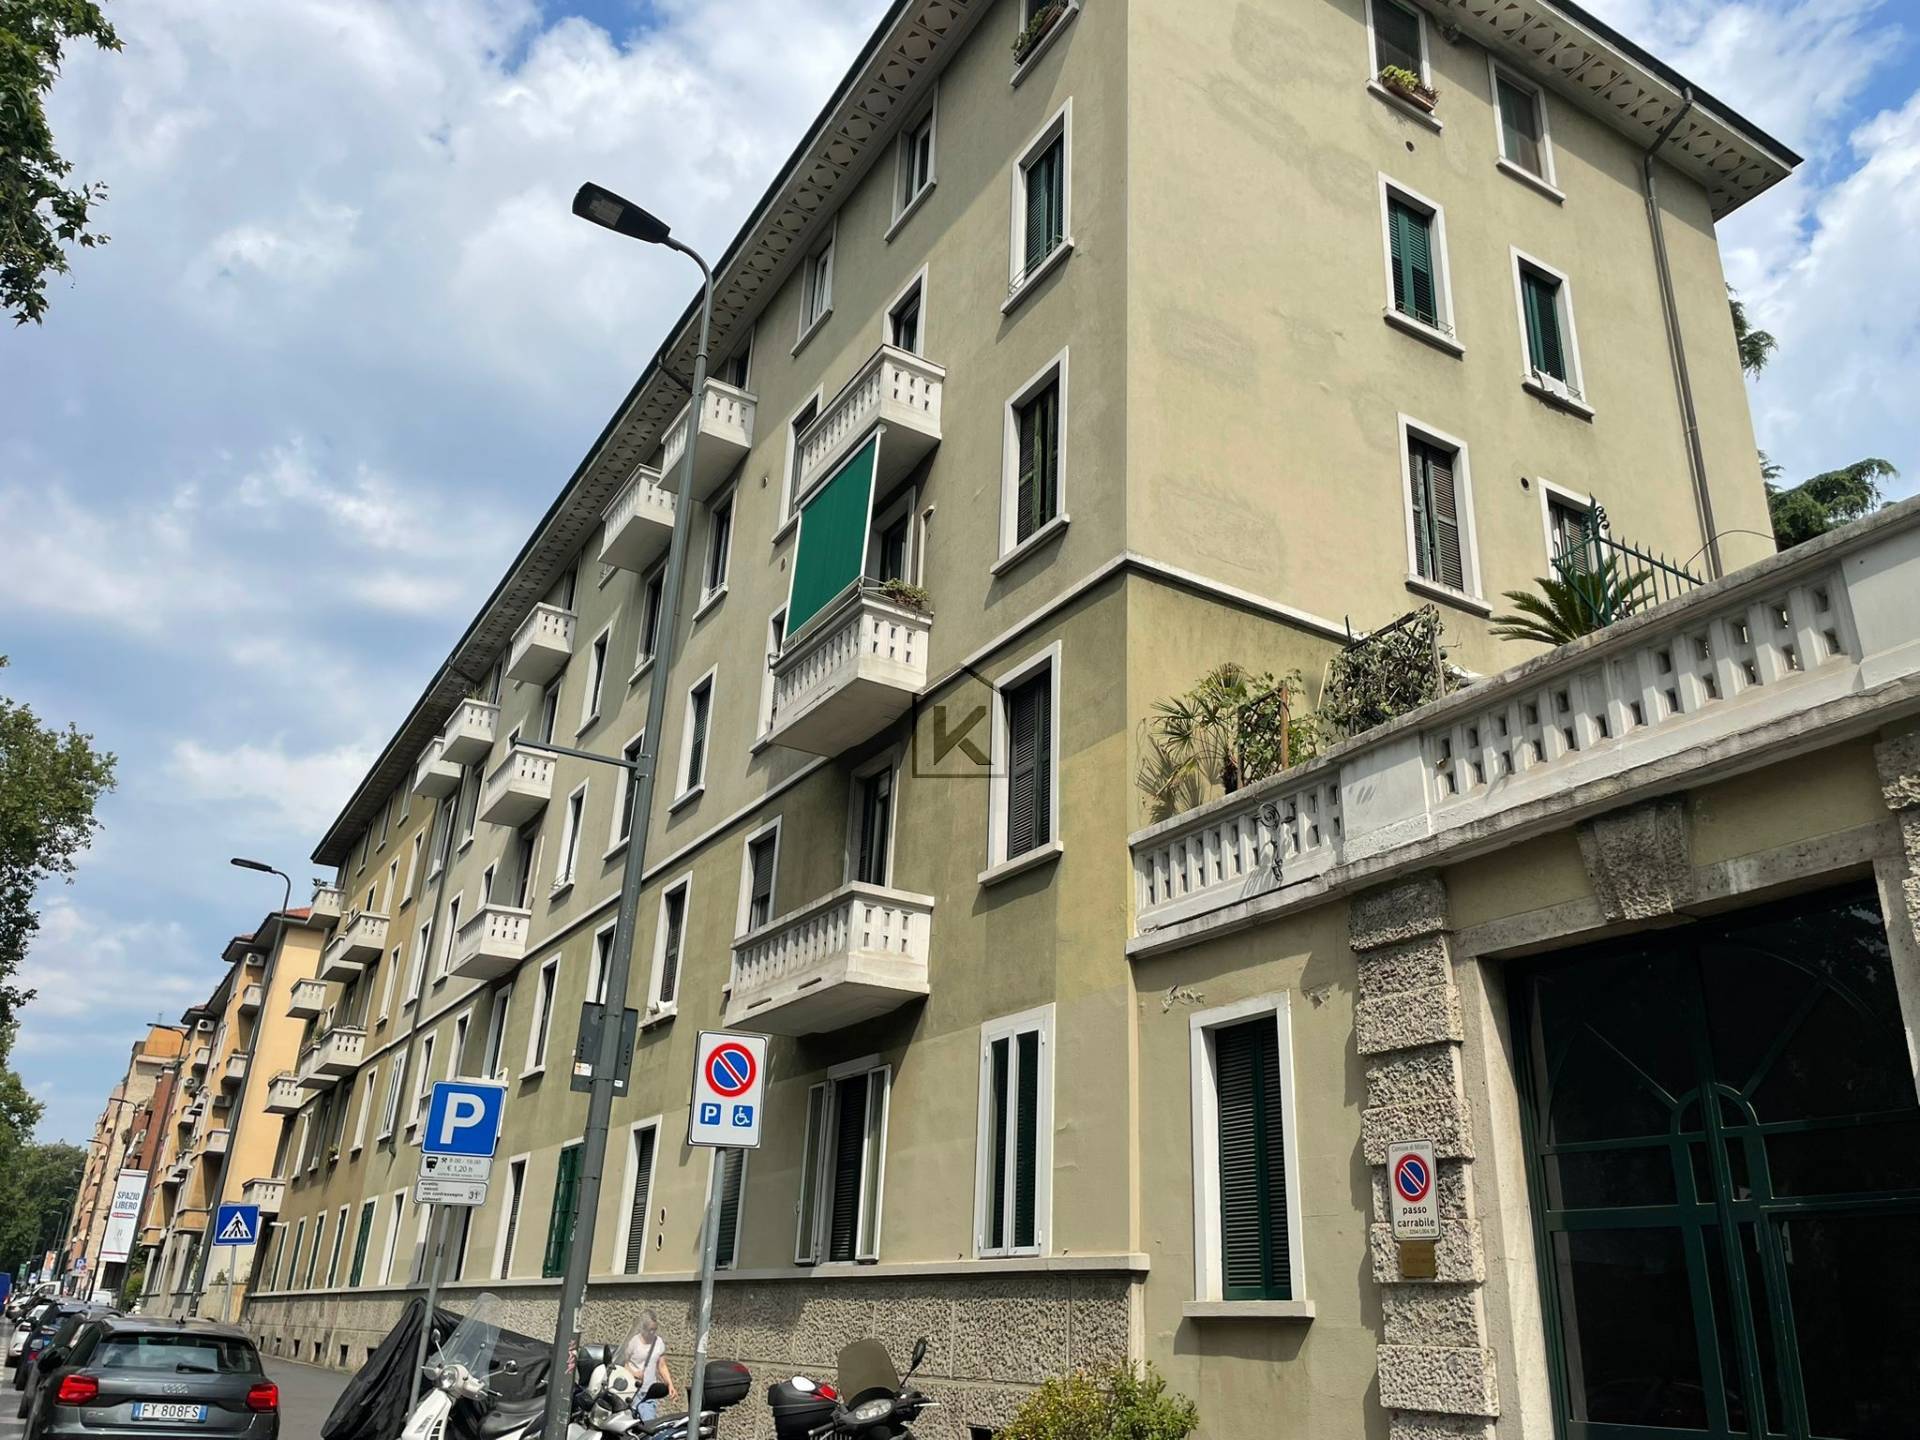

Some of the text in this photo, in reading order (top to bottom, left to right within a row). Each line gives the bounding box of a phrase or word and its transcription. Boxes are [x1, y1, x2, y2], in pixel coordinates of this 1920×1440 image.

[440, 1092, 486, 1144] P
[704, 1105, 718, 1122] P
[116, 1190, 141, 1202] SPAZIO
[114, 1200, 138, 1211] LIBERO
[1402, 1206, 1427, 1216] passo
[1397, 1217, 1435, 1228] carrabile
[142, 1404, 200, 1419] FY 808FS
